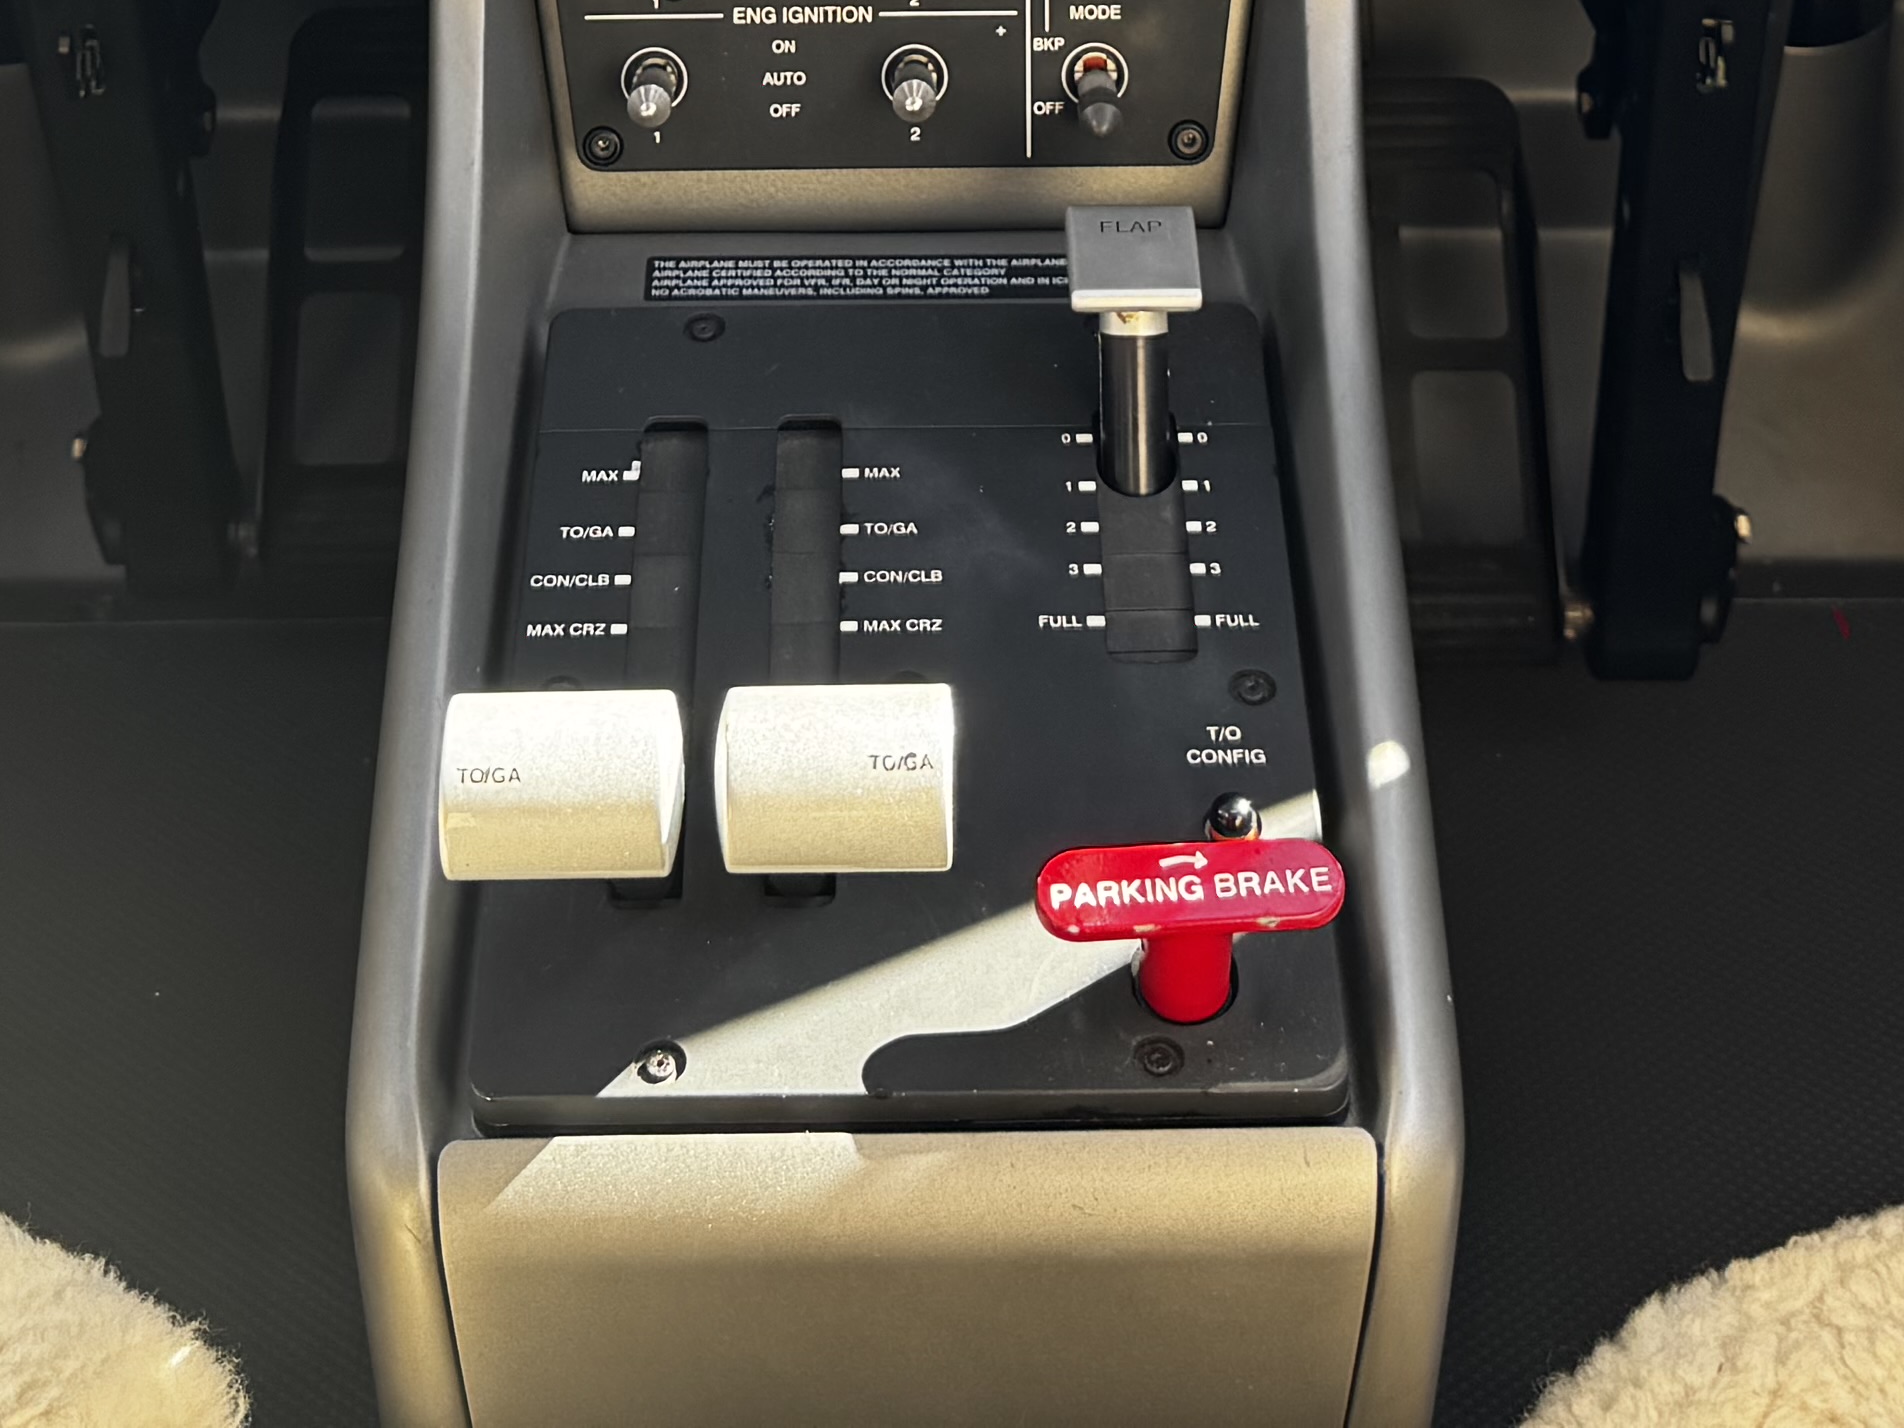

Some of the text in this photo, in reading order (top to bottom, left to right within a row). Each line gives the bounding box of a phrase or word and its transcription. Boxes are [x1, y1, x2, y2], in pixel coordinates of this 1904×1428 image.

[732, 5, 873, 25] ENG IGNITION
[1099, 220, 1162, 233] FLAP
[863, 569, 943, 583] CON/CLB
[526, 622, 607, 637] MAX CRZ
[1186, 748, 1267, 765] CONFIG
[1049, 866, 1333, 910] PARKING BRAKE
